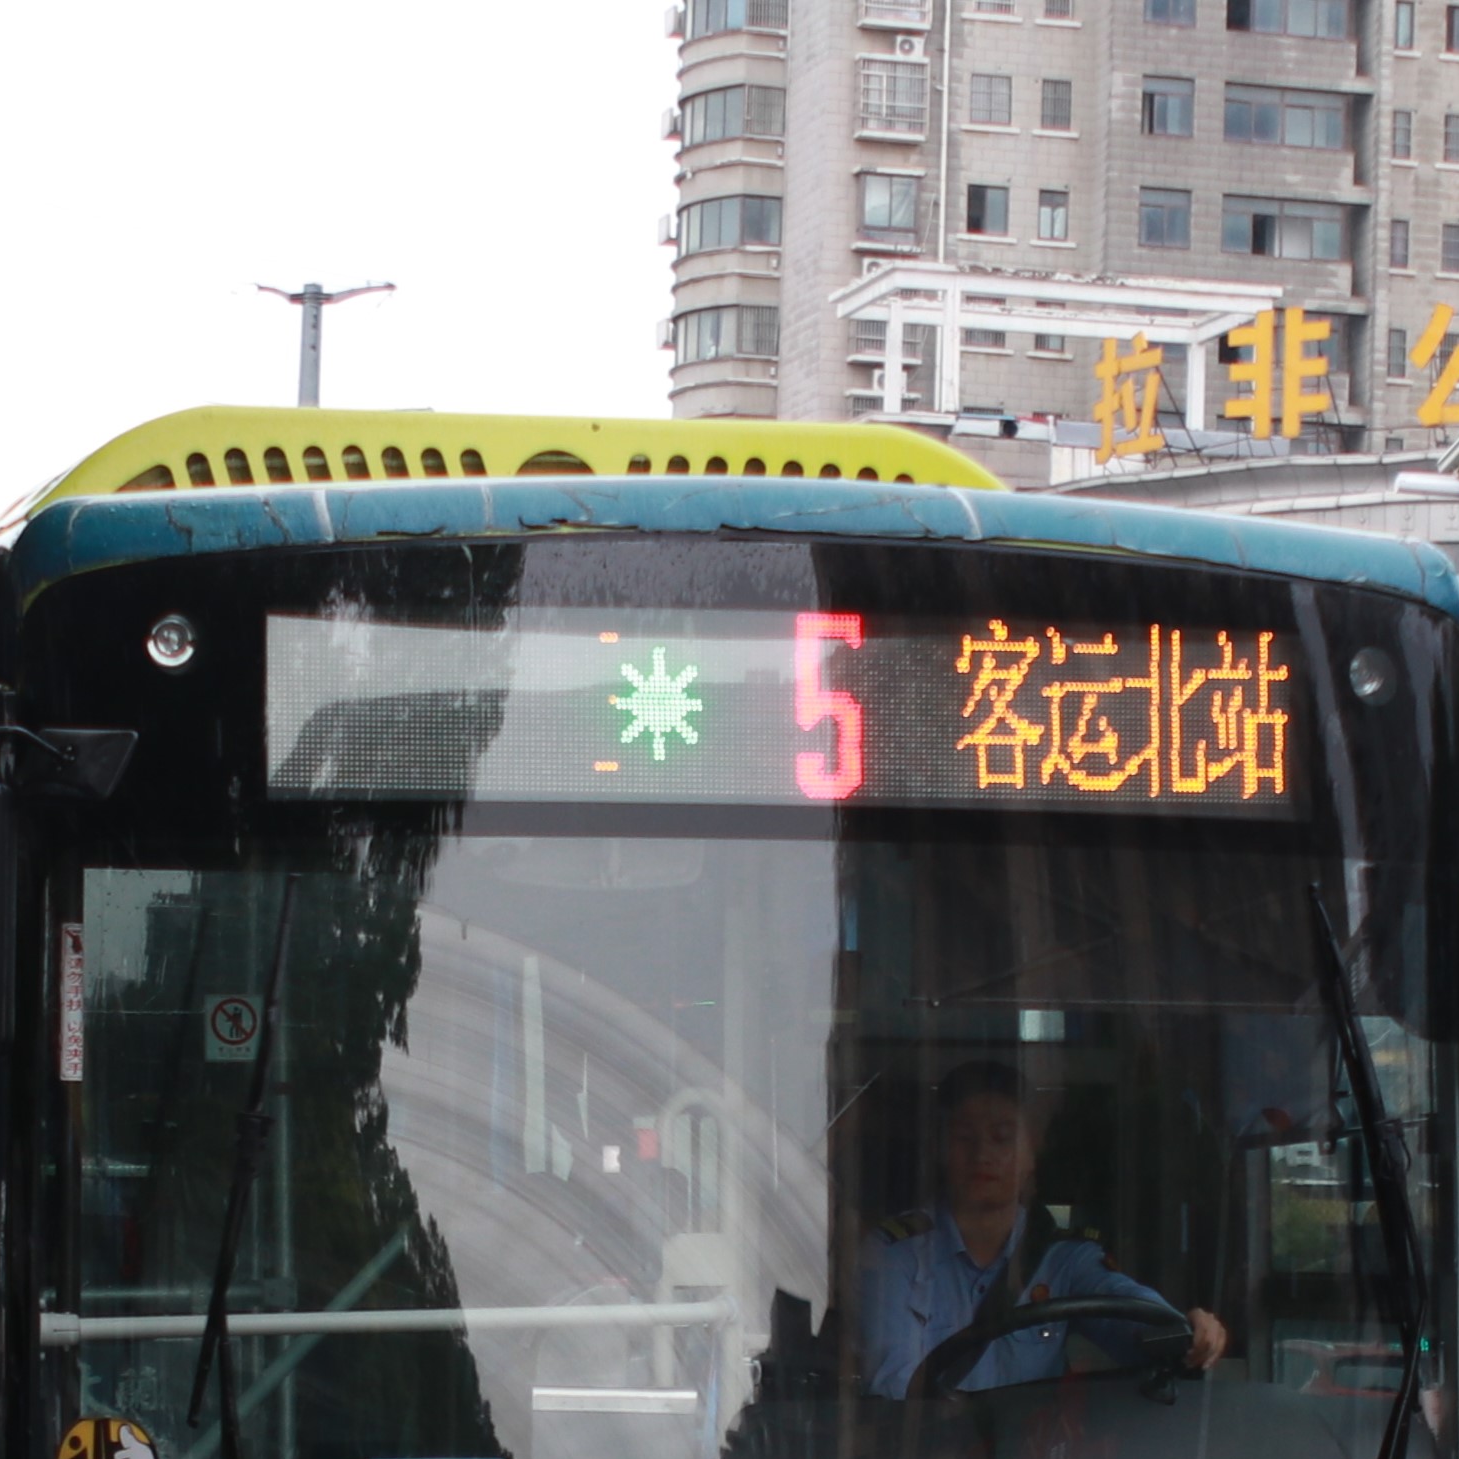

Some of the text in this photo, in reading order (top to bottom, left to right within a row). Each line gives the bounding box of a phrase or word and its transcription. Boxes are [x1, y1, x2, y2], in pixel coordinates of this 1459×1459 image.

[796, 613, 863, 800] 5
[957, 619, 1289, 799] 客运北站
